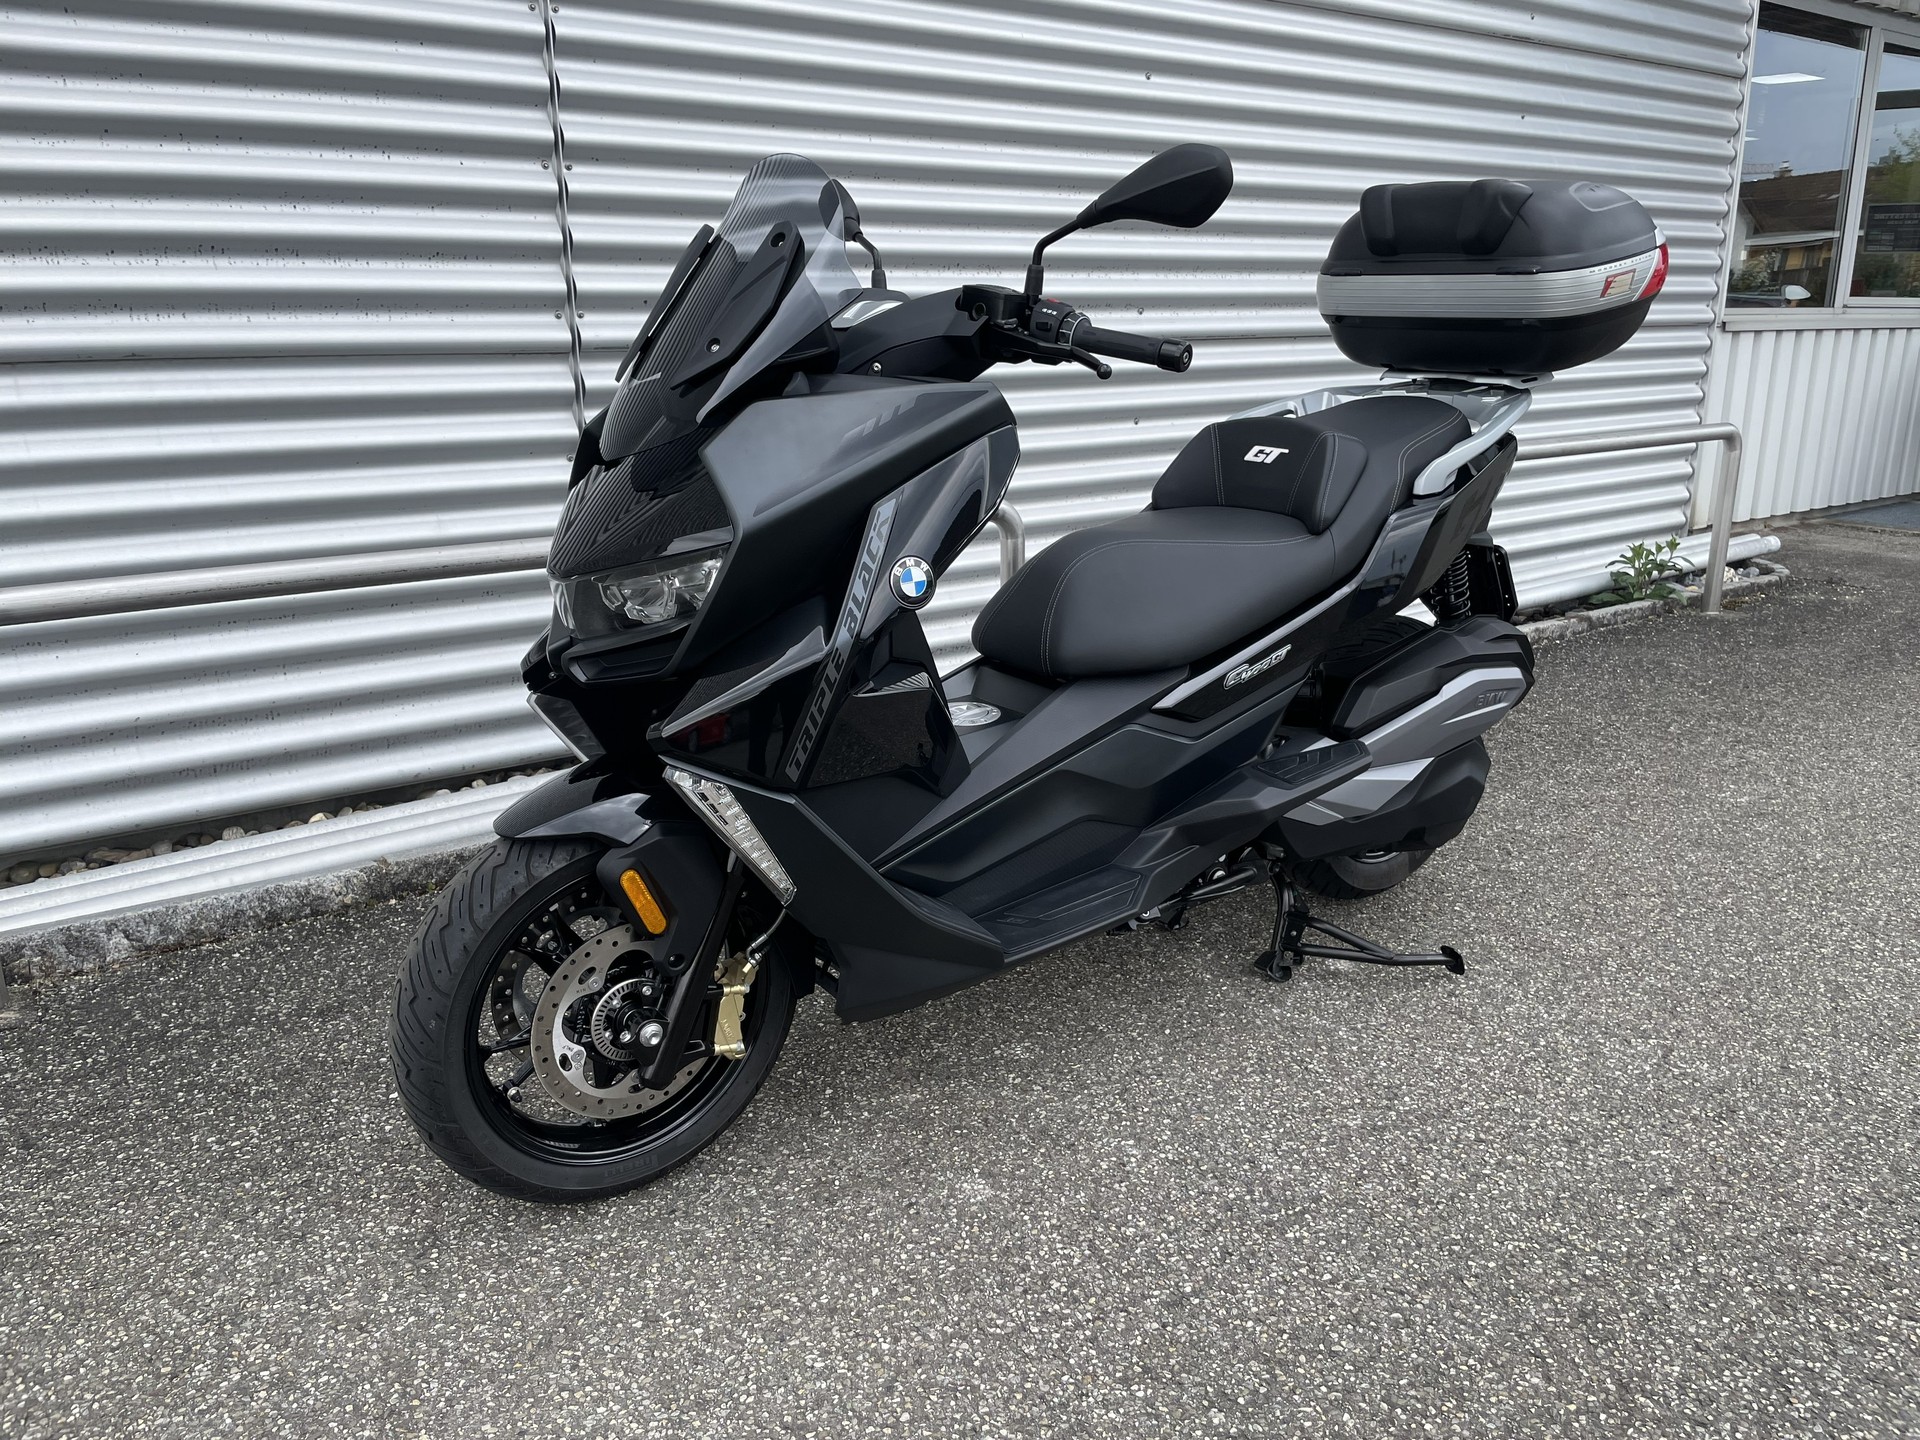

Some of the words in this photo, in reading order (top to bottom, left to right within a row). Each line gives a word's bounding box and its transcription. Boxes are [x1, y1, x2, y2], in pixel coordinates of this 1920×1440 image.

[1244, 445, 1289, 464] GT
[894, 559, 929, 576] BMW
[786, 646, 847, 782] TRIPLE
[843, 511, 890, 639] BLACK
